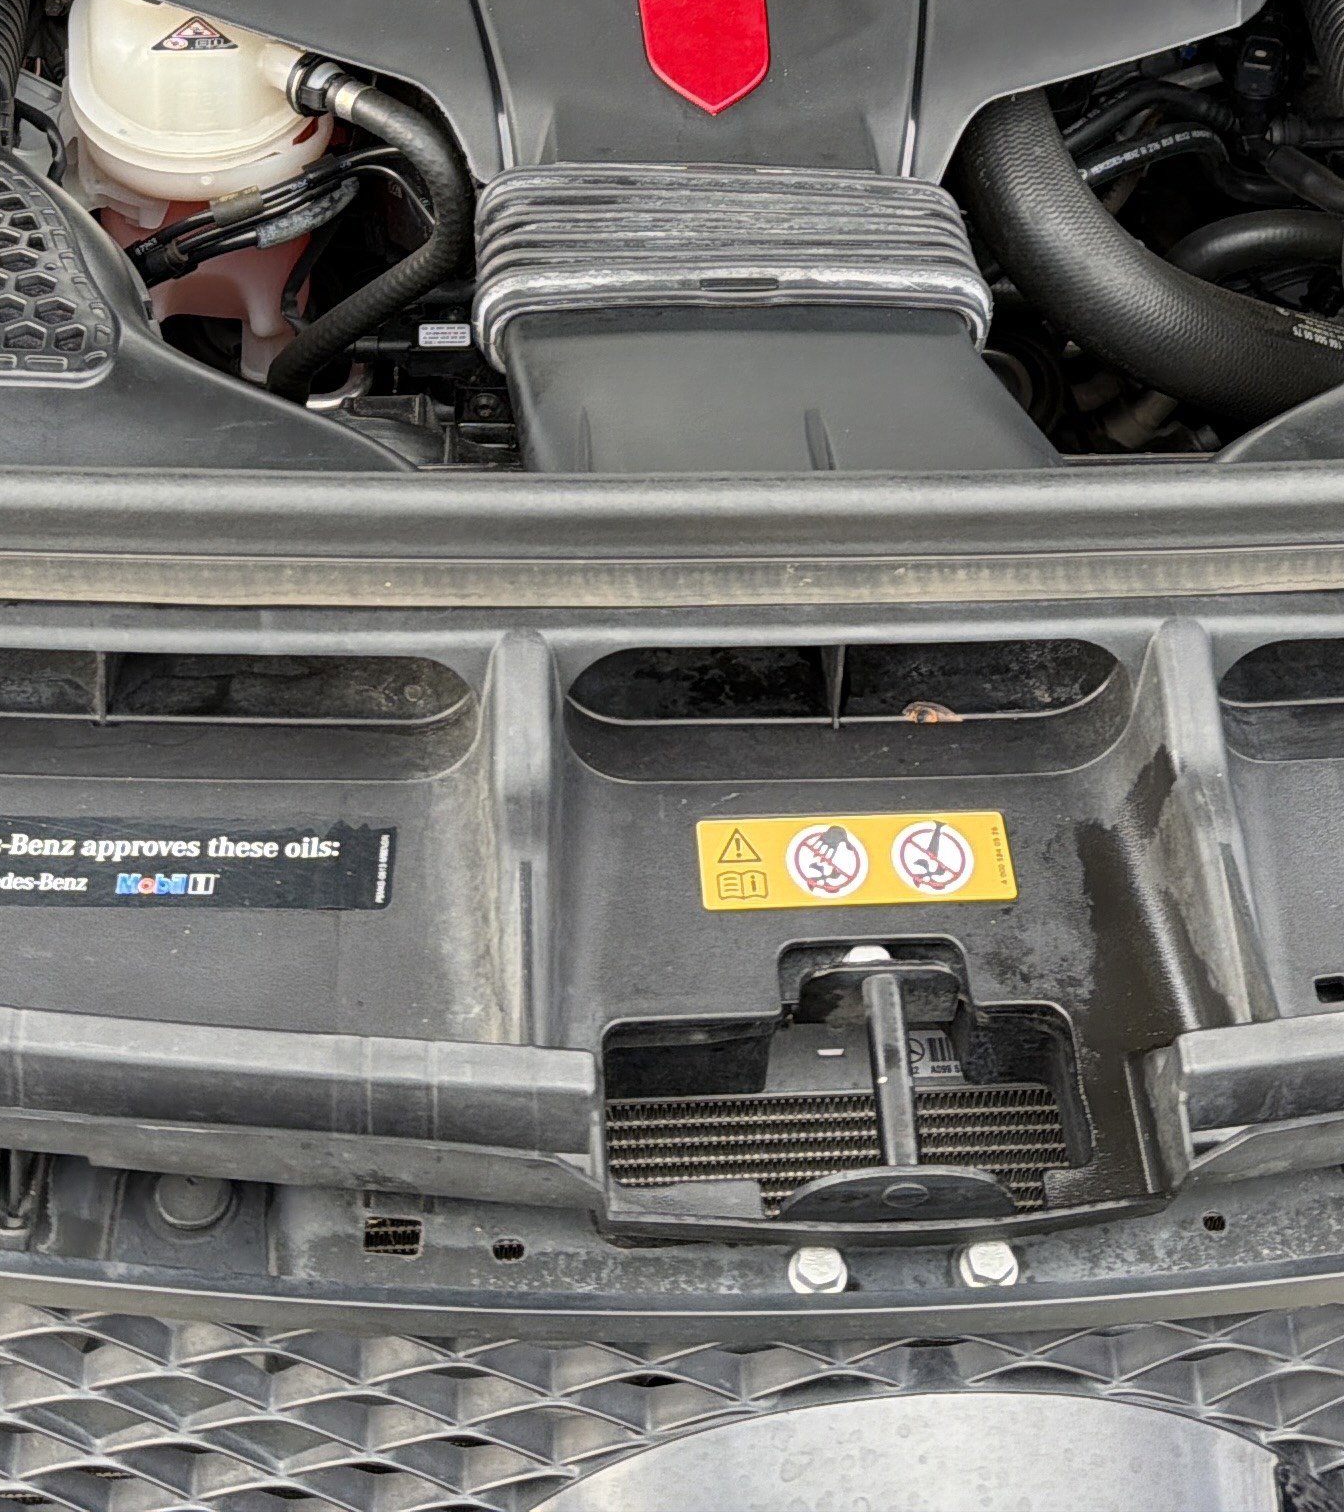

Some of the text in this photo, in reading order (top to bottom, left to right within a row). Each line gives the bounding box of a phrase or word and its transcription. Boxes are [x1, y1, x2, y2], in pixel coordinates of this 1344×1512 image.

[80, 838, 201, 862] approves
[207, 836, 279, 858] these
[284, 836, 341, 859] oils:
[115, 873, 188, 895] Mobil
